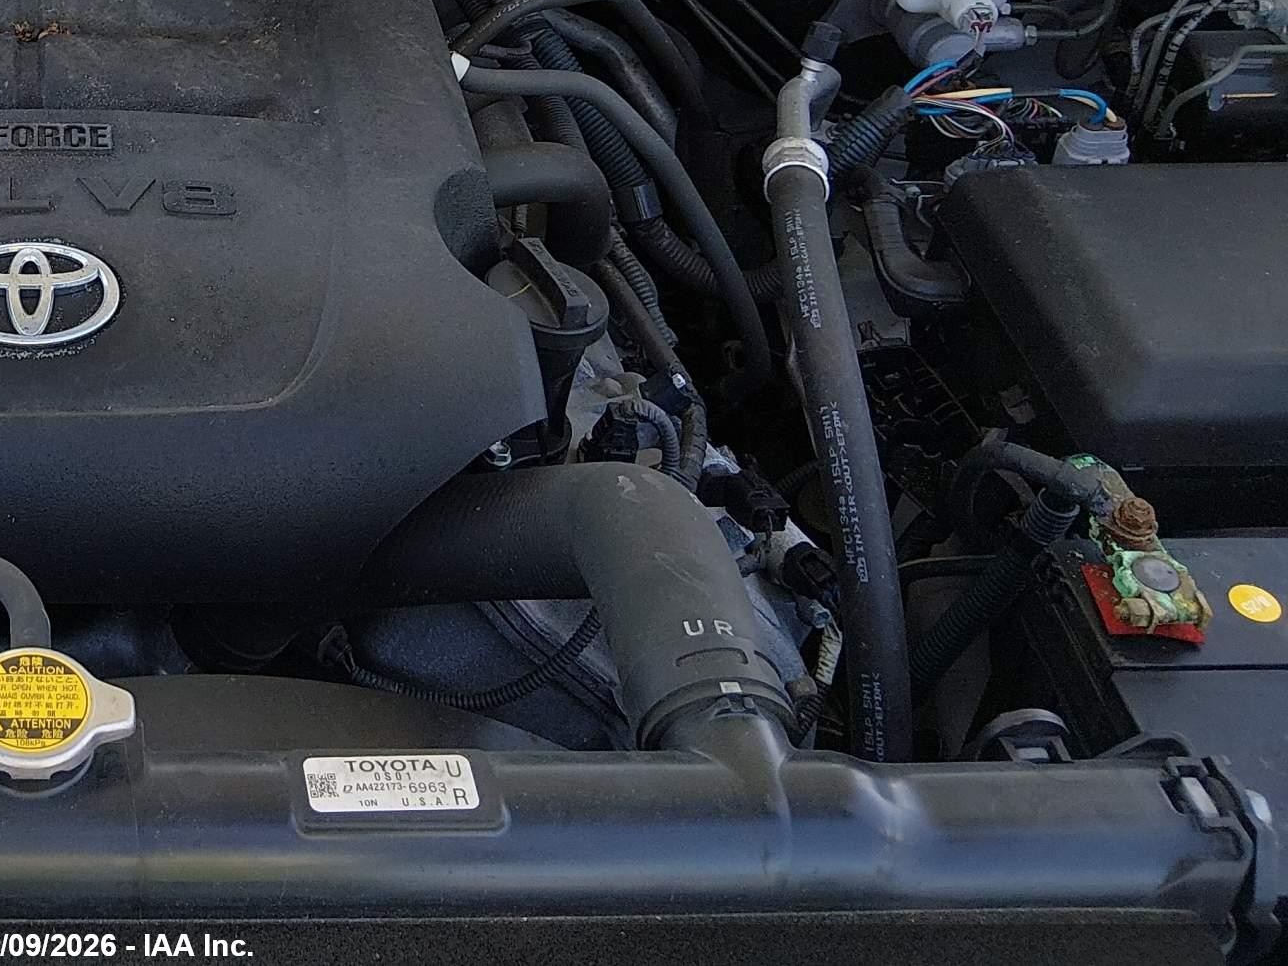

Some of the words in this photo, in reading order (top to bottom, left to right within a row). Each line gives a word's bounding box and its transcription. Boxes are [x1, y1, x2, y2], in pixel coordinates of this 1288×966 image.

[75, 176, 238, 218] V8
[9, 666, 64, 675] CAUTION
[11, 719, 72, 729] ATTENTION
[344, 759, 436, 772] TOYOTA
[445, 760, 462, 778] U
[452, 788, 469, 806] R
